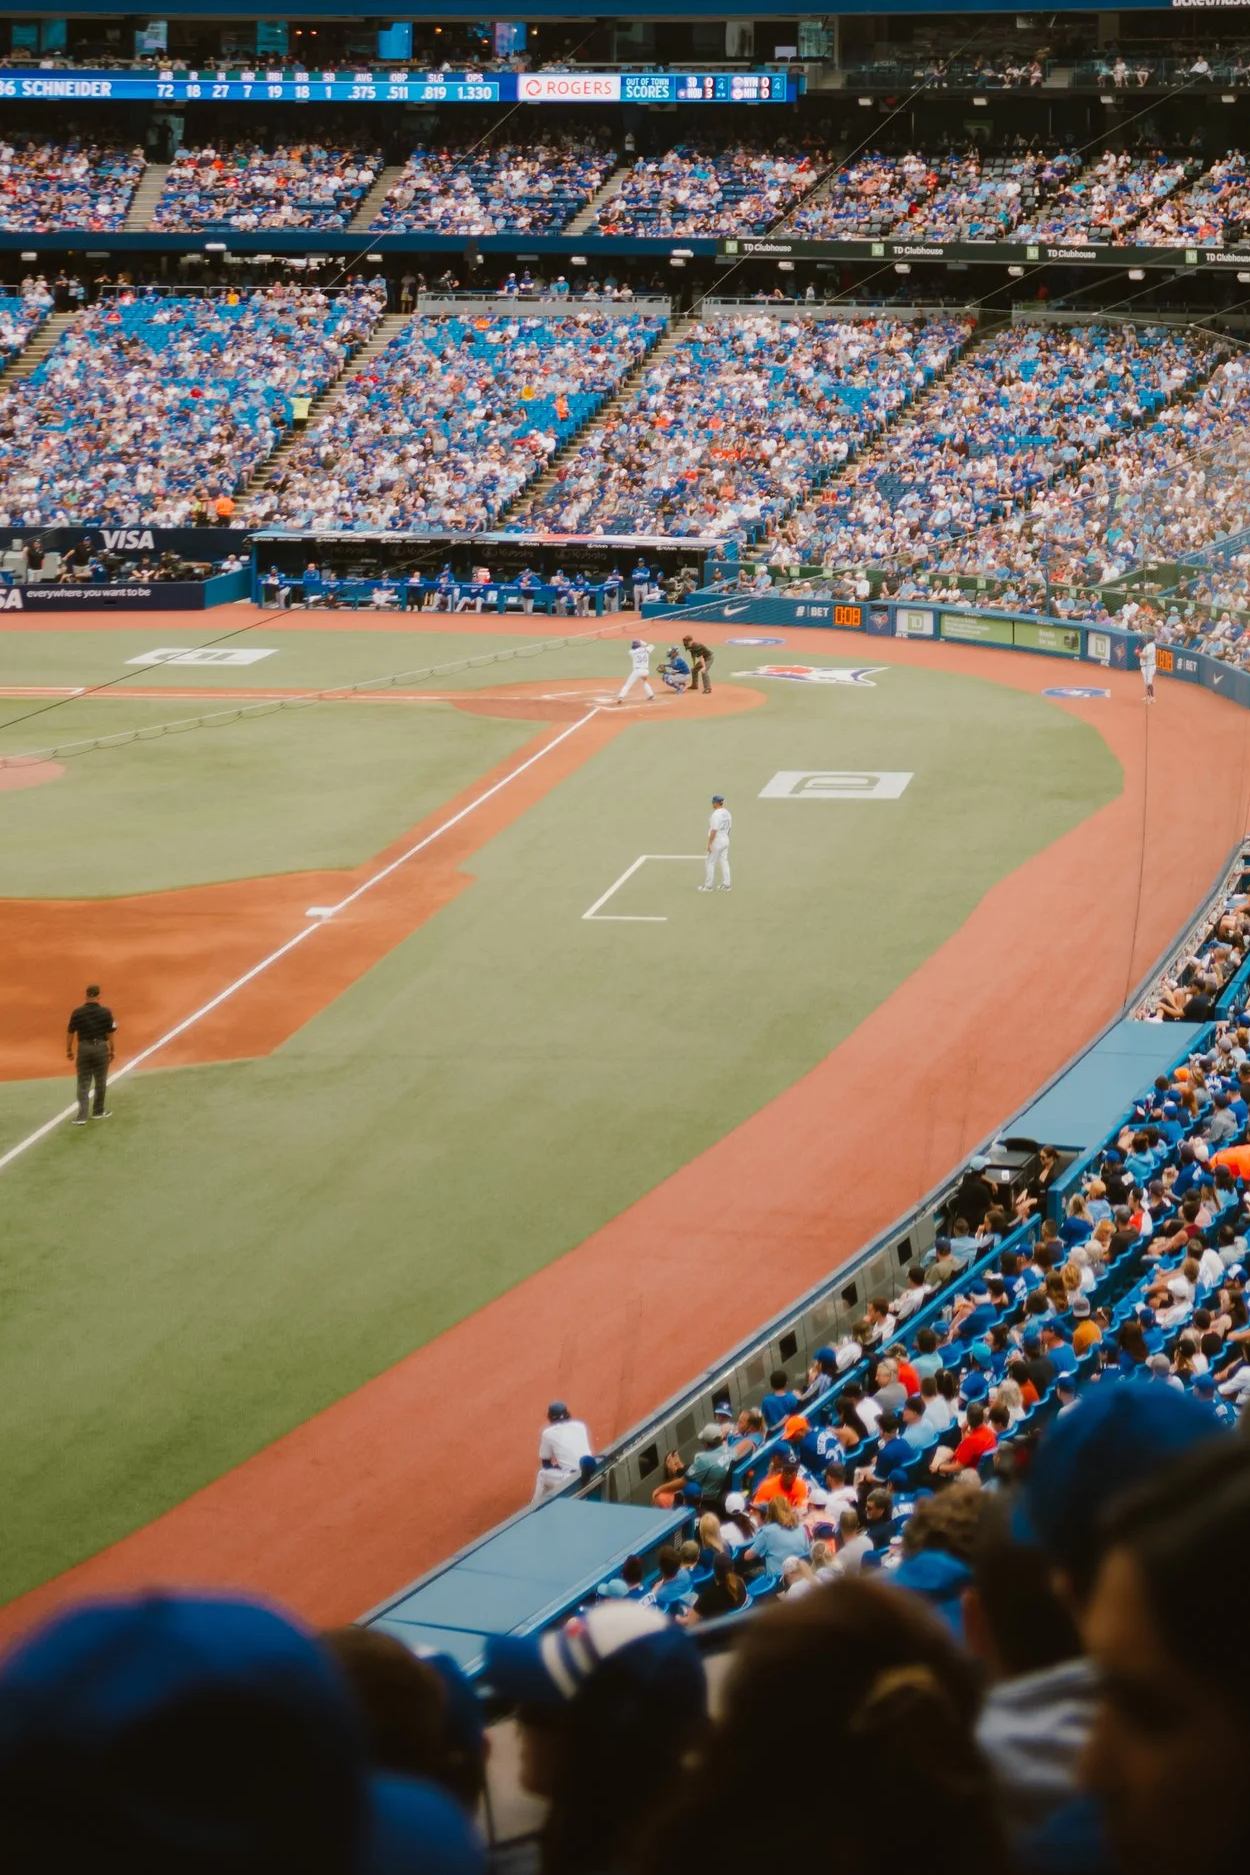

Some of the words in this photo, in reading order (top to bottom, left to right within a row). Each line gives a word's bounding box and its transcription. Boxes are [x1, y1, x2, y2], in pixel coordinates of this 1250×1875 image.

[159, 71, 173, 81] AB
[323, 72, 335, 82] SB
[354, 73, 373, 83] AVG
[427, 73, 444, 83] SLG
[466, 73, 484, 83] OPS
[626, 78, 639, 86] OUT
[641, 78, 649, 86] OF
[650, 78, 670, 87] TOWN
[22, 81, 112, 97] SCHNEIDER
[547, 81, 613, 95] ROGERS
[704, 77, 714, 88] 0
[717, 82, 725, 90] 4
[157, 84, 174, 97] 72
[186, 84, 201, 98] 18
[212, 85, 230, 98] 27
[243, 85, 253, 98] 7
[267, 85, 283, 99] 19
[295, 85, 310, 99] 18
[325, 85, 332, 99] 1
[347, 86, 376, 99] .375
[387, 86, 408, 99] .511
[421, 86, 447, 99] .819
[457, 86, 492, 100] 1.330
[626, 86, 670, 98] SCORES
[704, 88, 713, 99] 3
[743, 243, 757, 251] TD
[756, 244, 792, 253] Clubhouse
[893, 246, 906, 255] TD
[906, 246, 943, 256] Clubhouse
[1047, 249, 1060, 258] TD
[1060, 250, 1096, 259] Clubhouse
[1206, 253, 1219, 262] TD
[99, 530, 155, 549] VISA
[26, 589, 82, 600] everywhere
[83, 589, 101, 599] you
[102, 589, 126, 598] want
[127, 588, 137, 597] to
[137, 587, 152, 597] be
[810, 606, 829, 617] BET
[835, 605, 861, 626] 0:08
[1185, 662, 1197, 672] BET
